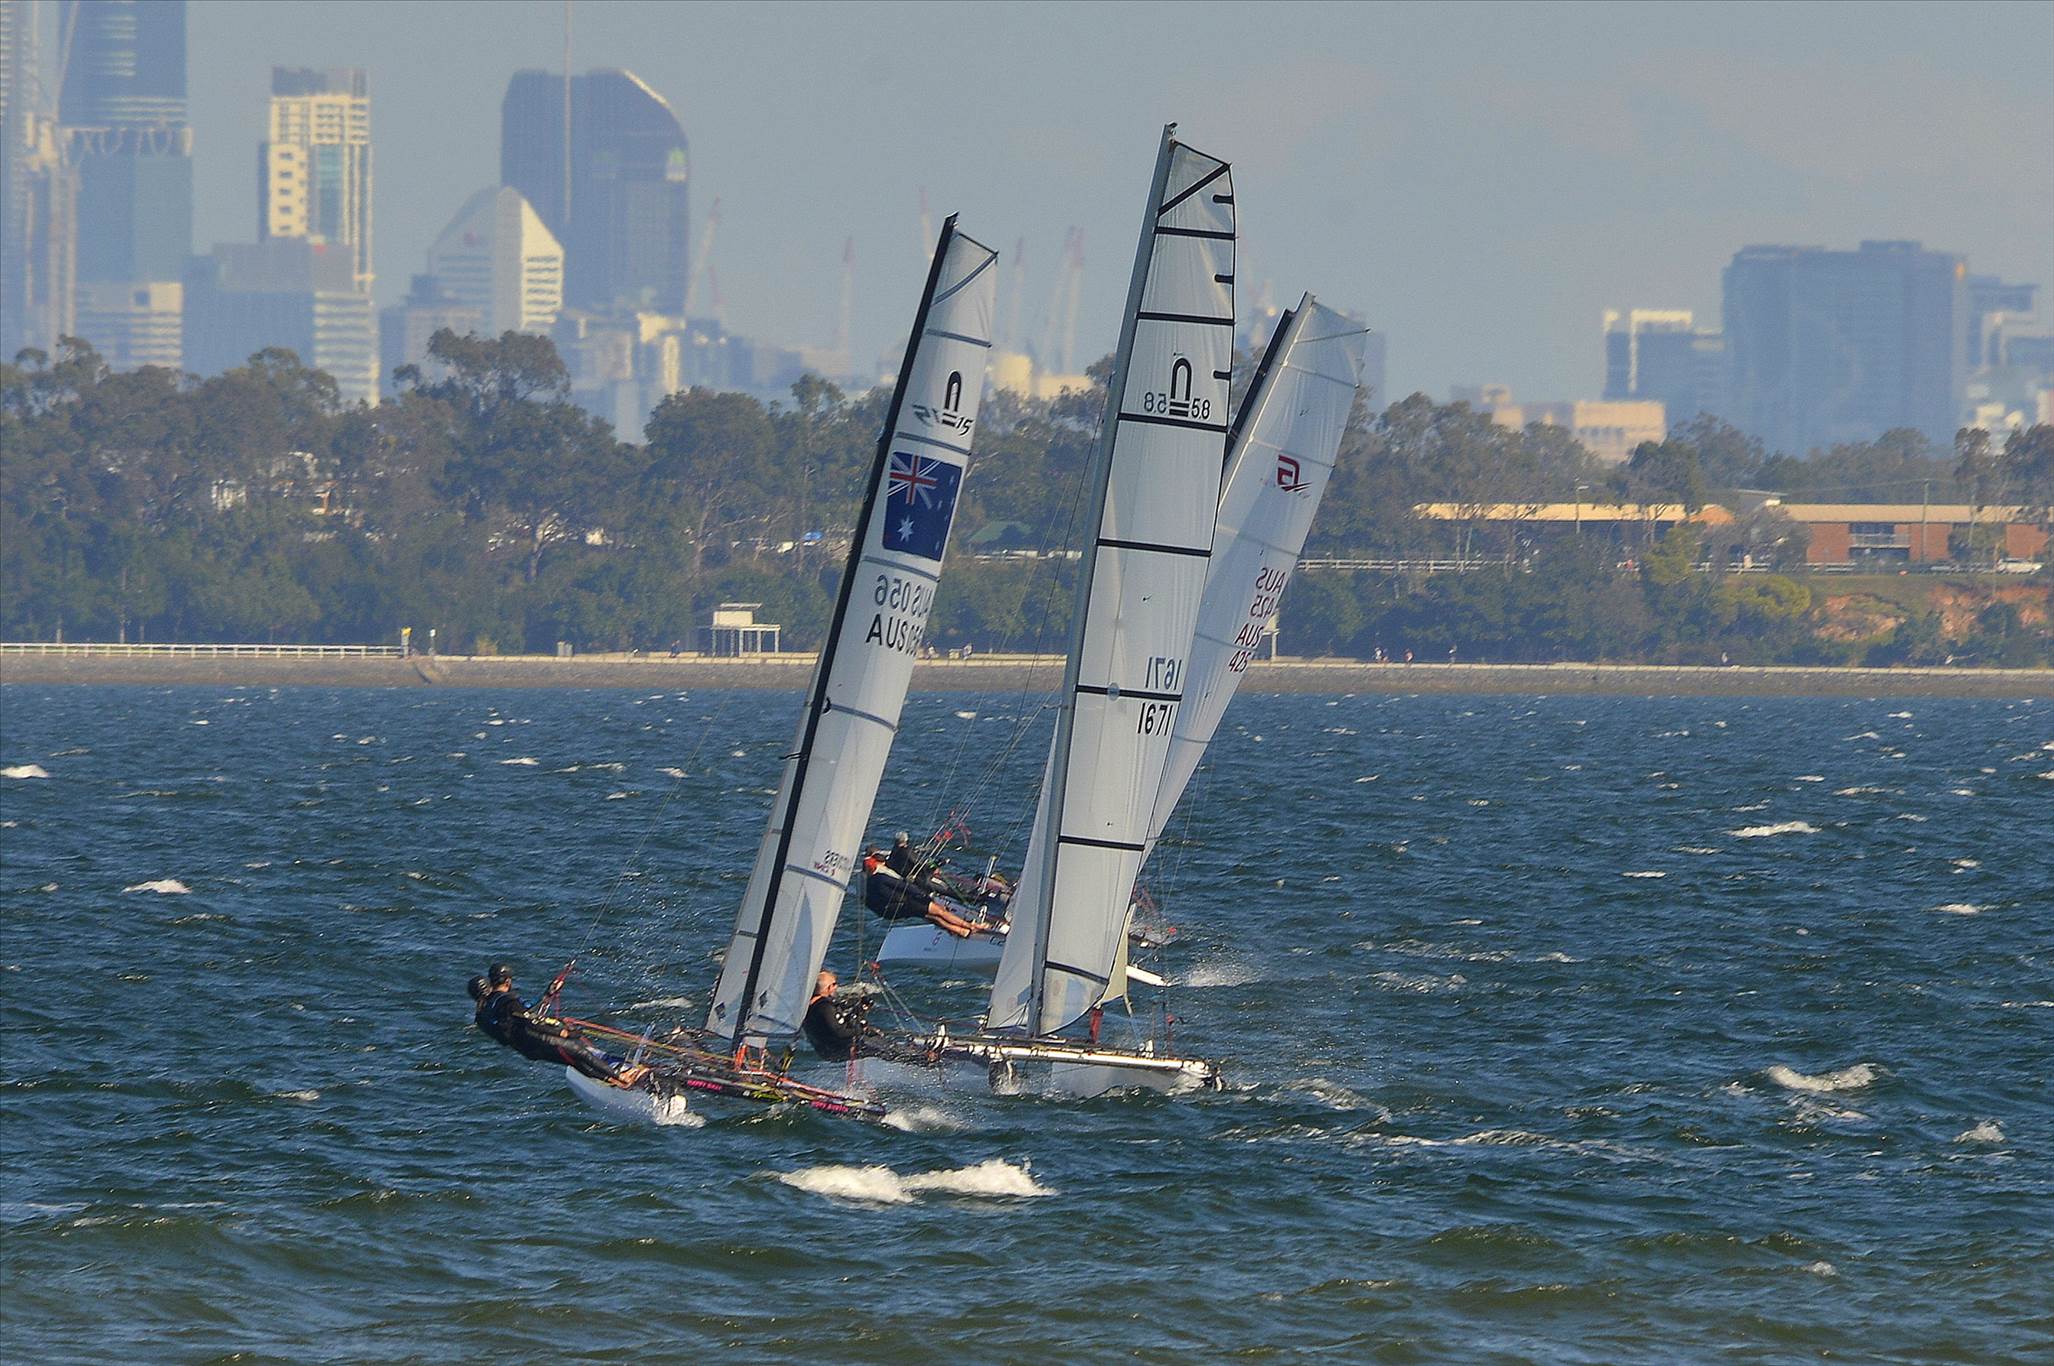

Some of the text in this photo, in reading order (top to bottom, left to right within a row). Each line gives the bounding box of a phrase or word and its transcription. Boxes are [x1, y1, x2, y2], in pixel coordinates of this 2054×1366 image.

[956, 416, 974, 436] 15
[1234, 622, 1265, 648] AUS
[1137, 702, 1173, 736] 1671
